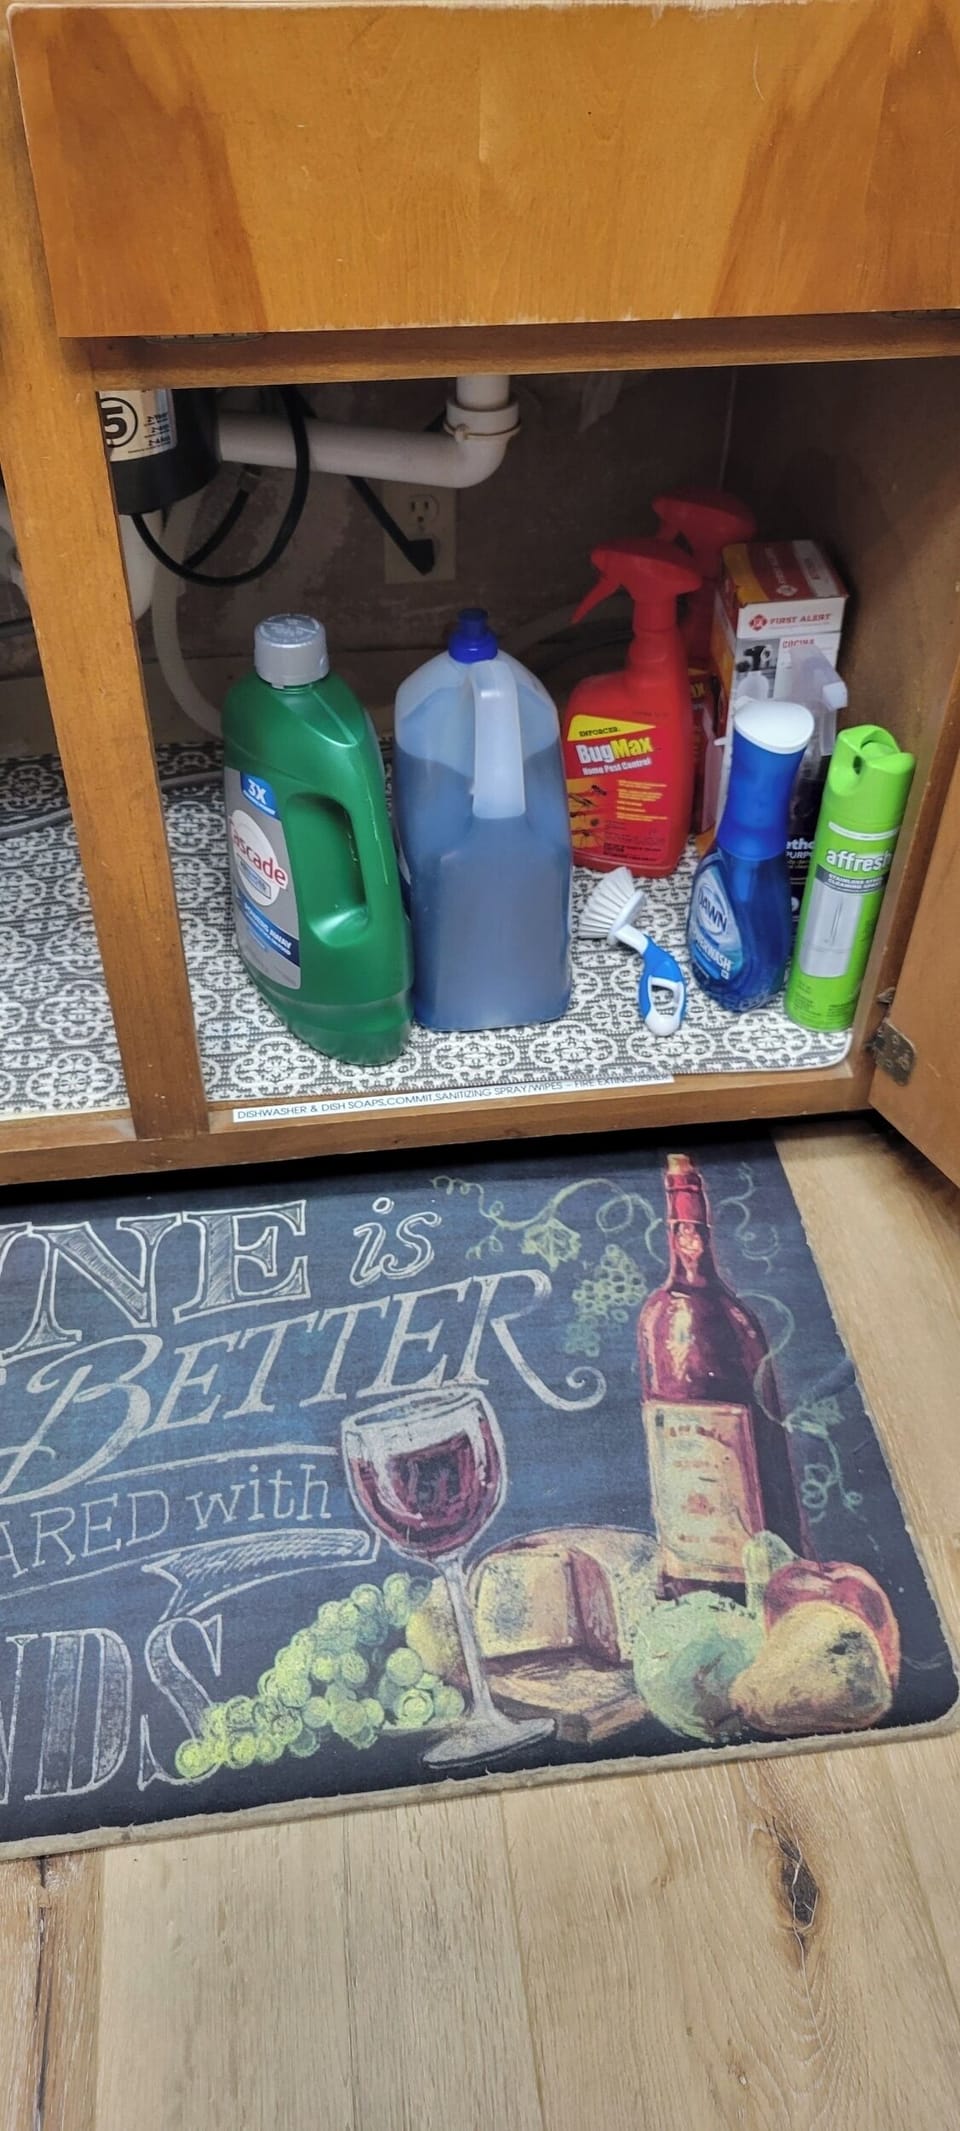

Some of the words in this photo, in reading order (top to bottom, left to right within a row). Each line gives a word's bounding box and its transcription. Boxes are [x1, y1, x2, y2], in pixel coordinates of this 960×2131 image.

[101, 406, 127, 440] 5
[770, 616, 797, 625] FIRST
[800, 613, 831, 622] ALERT
[576, 737, 653, 763] BugMax
[582, 767, 604, 776] Home
[604, 763, 622, 772] Pest
[621, 757, 652, 770] Control
[248, 779, 266, 805] 3X
[826, 849, 892, 872] affresh
[700, 888, 727, 932] DAWN
[237, 1106, 307, 1119] DISHWASHER
[321, 1103, 346, 1112] DISH
[574, 1078, 597, 1088] FIRE
[0, 1200, 311, 1368] NE
[349, 1197, 442, 1288] is
[0, 1269, 607, 1505] BETTER
[185, 1464, 332, 1531] with
